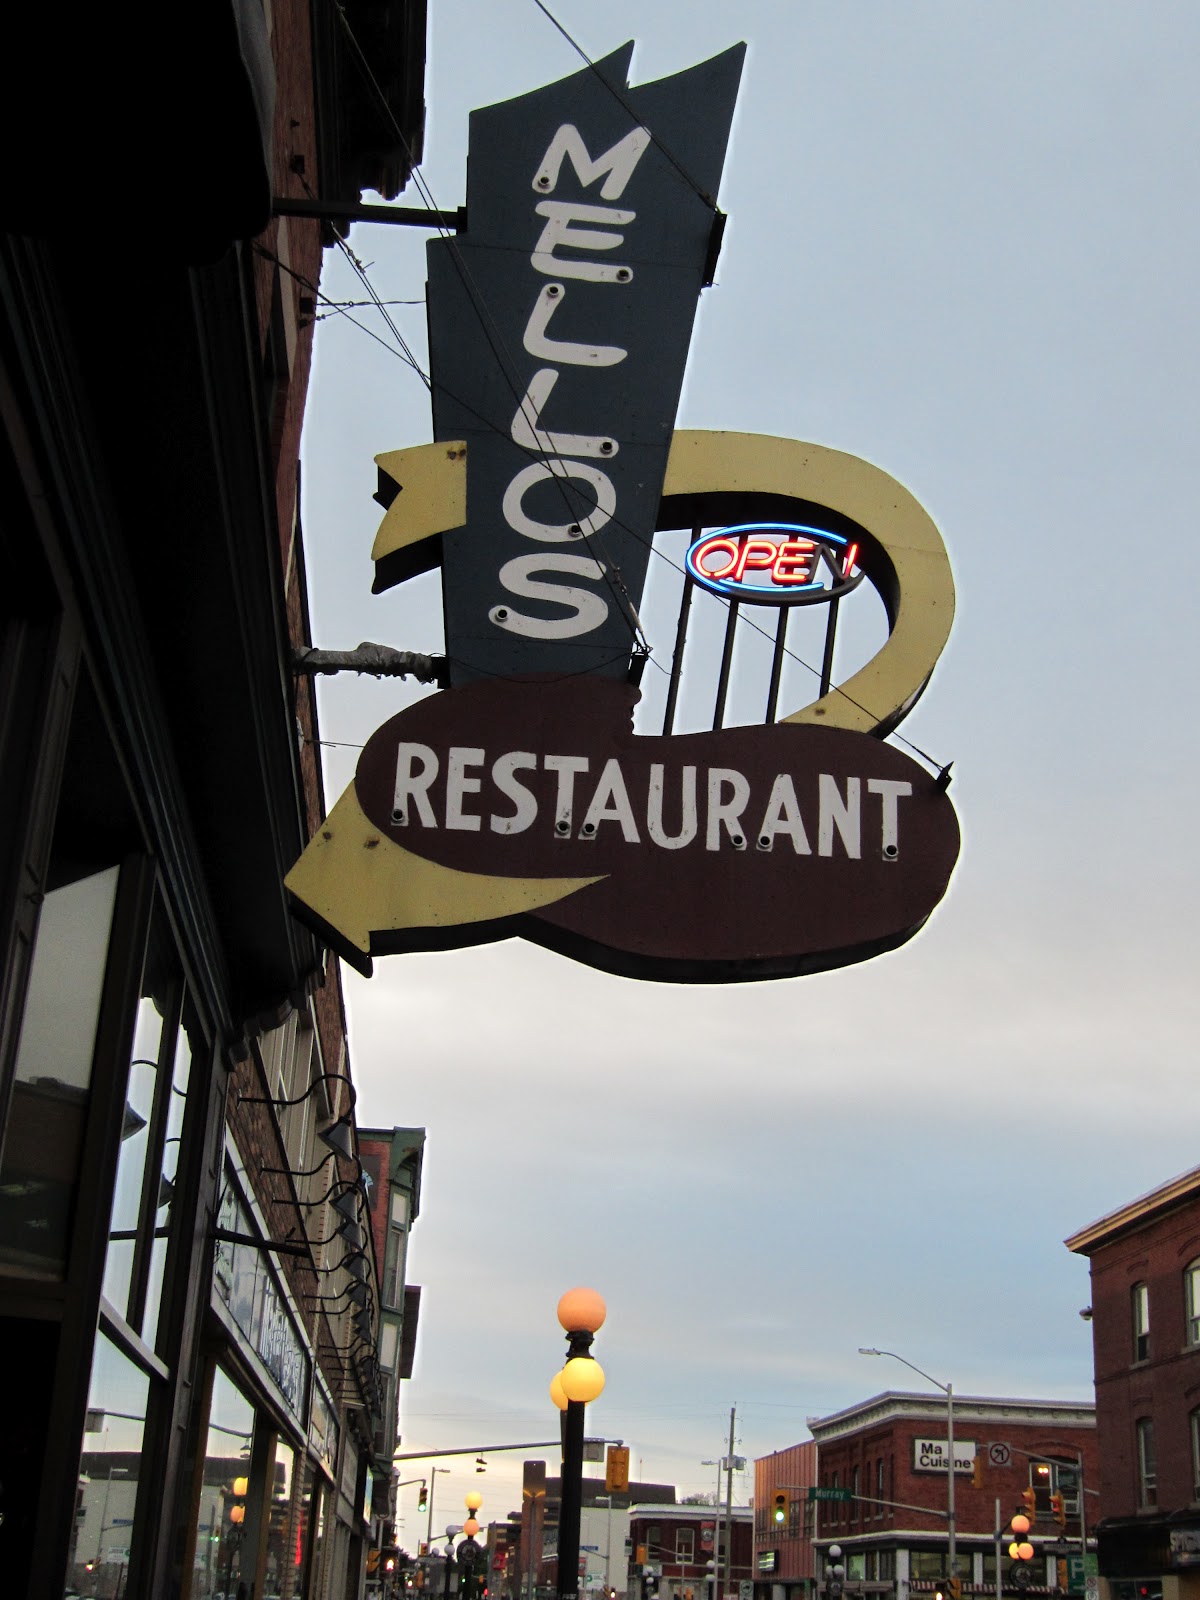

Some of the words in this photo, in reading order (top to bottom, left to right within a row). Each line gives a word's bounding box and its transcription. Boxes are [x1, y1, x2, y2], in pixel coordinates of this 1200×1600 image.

[488, 123, 649, 641] MELLOS
[694, 539, 858, 582] OPEN
[391, 740, 912, 863] RESTAURANT
[920, 1455, 971, 1469] Cuisne
[921, 1442, 942, 1455] Ma
